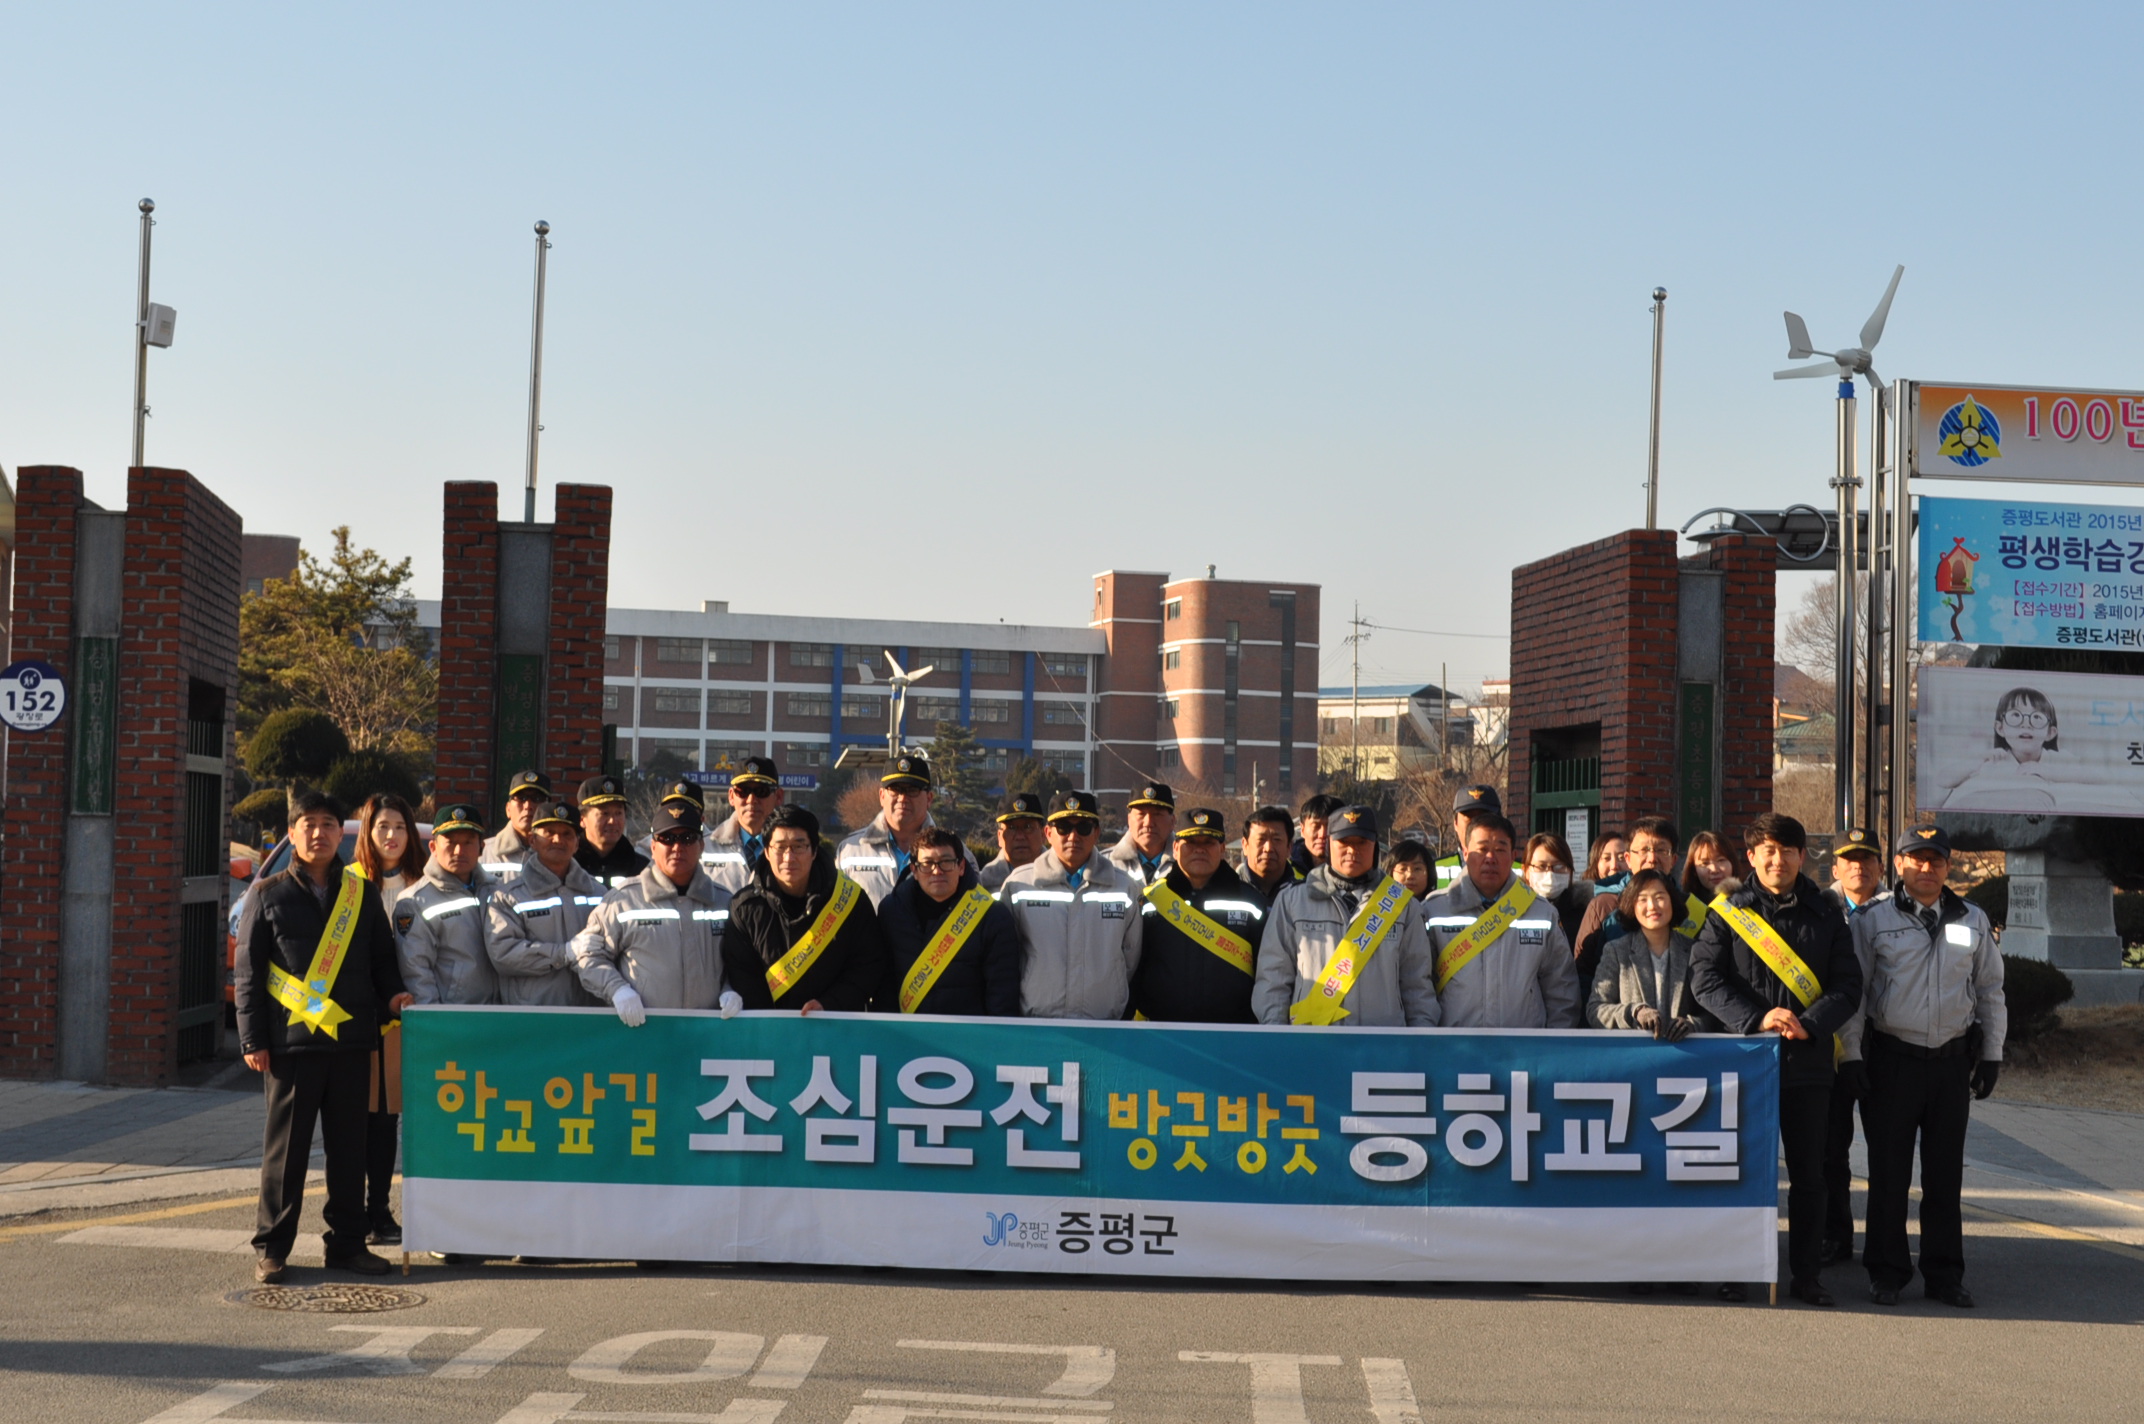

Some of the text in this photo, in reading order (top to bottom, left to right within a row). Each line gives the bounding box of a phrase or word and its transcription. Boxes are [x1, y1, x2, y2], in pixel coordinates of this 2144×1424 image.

[2001, 509, 2142, 531] 증평도서관 2015년
[2093, 584, 2144, 601] 2015년
[5, 690, 56, 712] 152
[701, 773, 727, 783] 바르게
[786, 775, 809, 786] 어린이
[1322, 957, 1353, 998] 추방
[434, 1054, 1740, 1182] 학교앞길 조심운전 방긋방긋 등하교길
[1019, 1221, 1049, 1241] 증평군
[1055, 1211, 1178, 1255] 증평군
[1007, 1240, 1048, 1250] Jeung Pyeong
